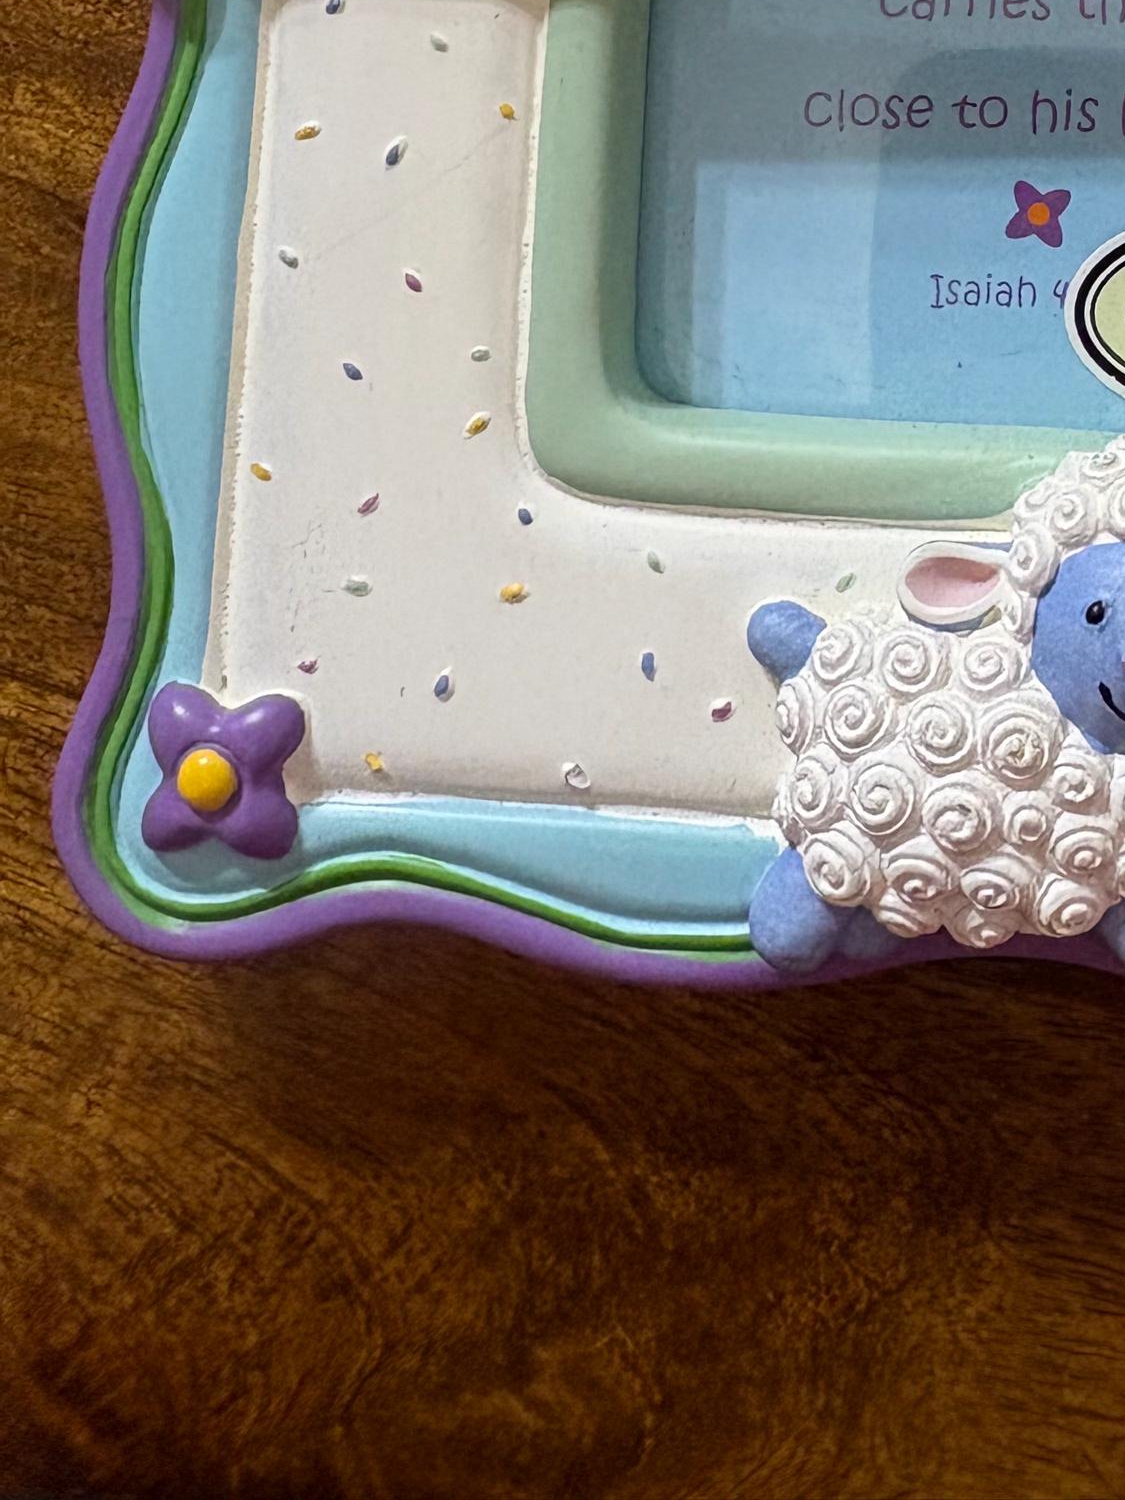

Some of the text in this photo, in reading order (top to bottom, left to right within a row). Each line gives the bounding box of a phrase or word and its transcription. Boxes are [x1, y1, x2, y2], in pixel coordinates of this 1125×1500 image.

[951, 95, 1008, 129] to
[1031, 89, 1099, 135] his
[930, 273, 1036, 308] Isaiah
